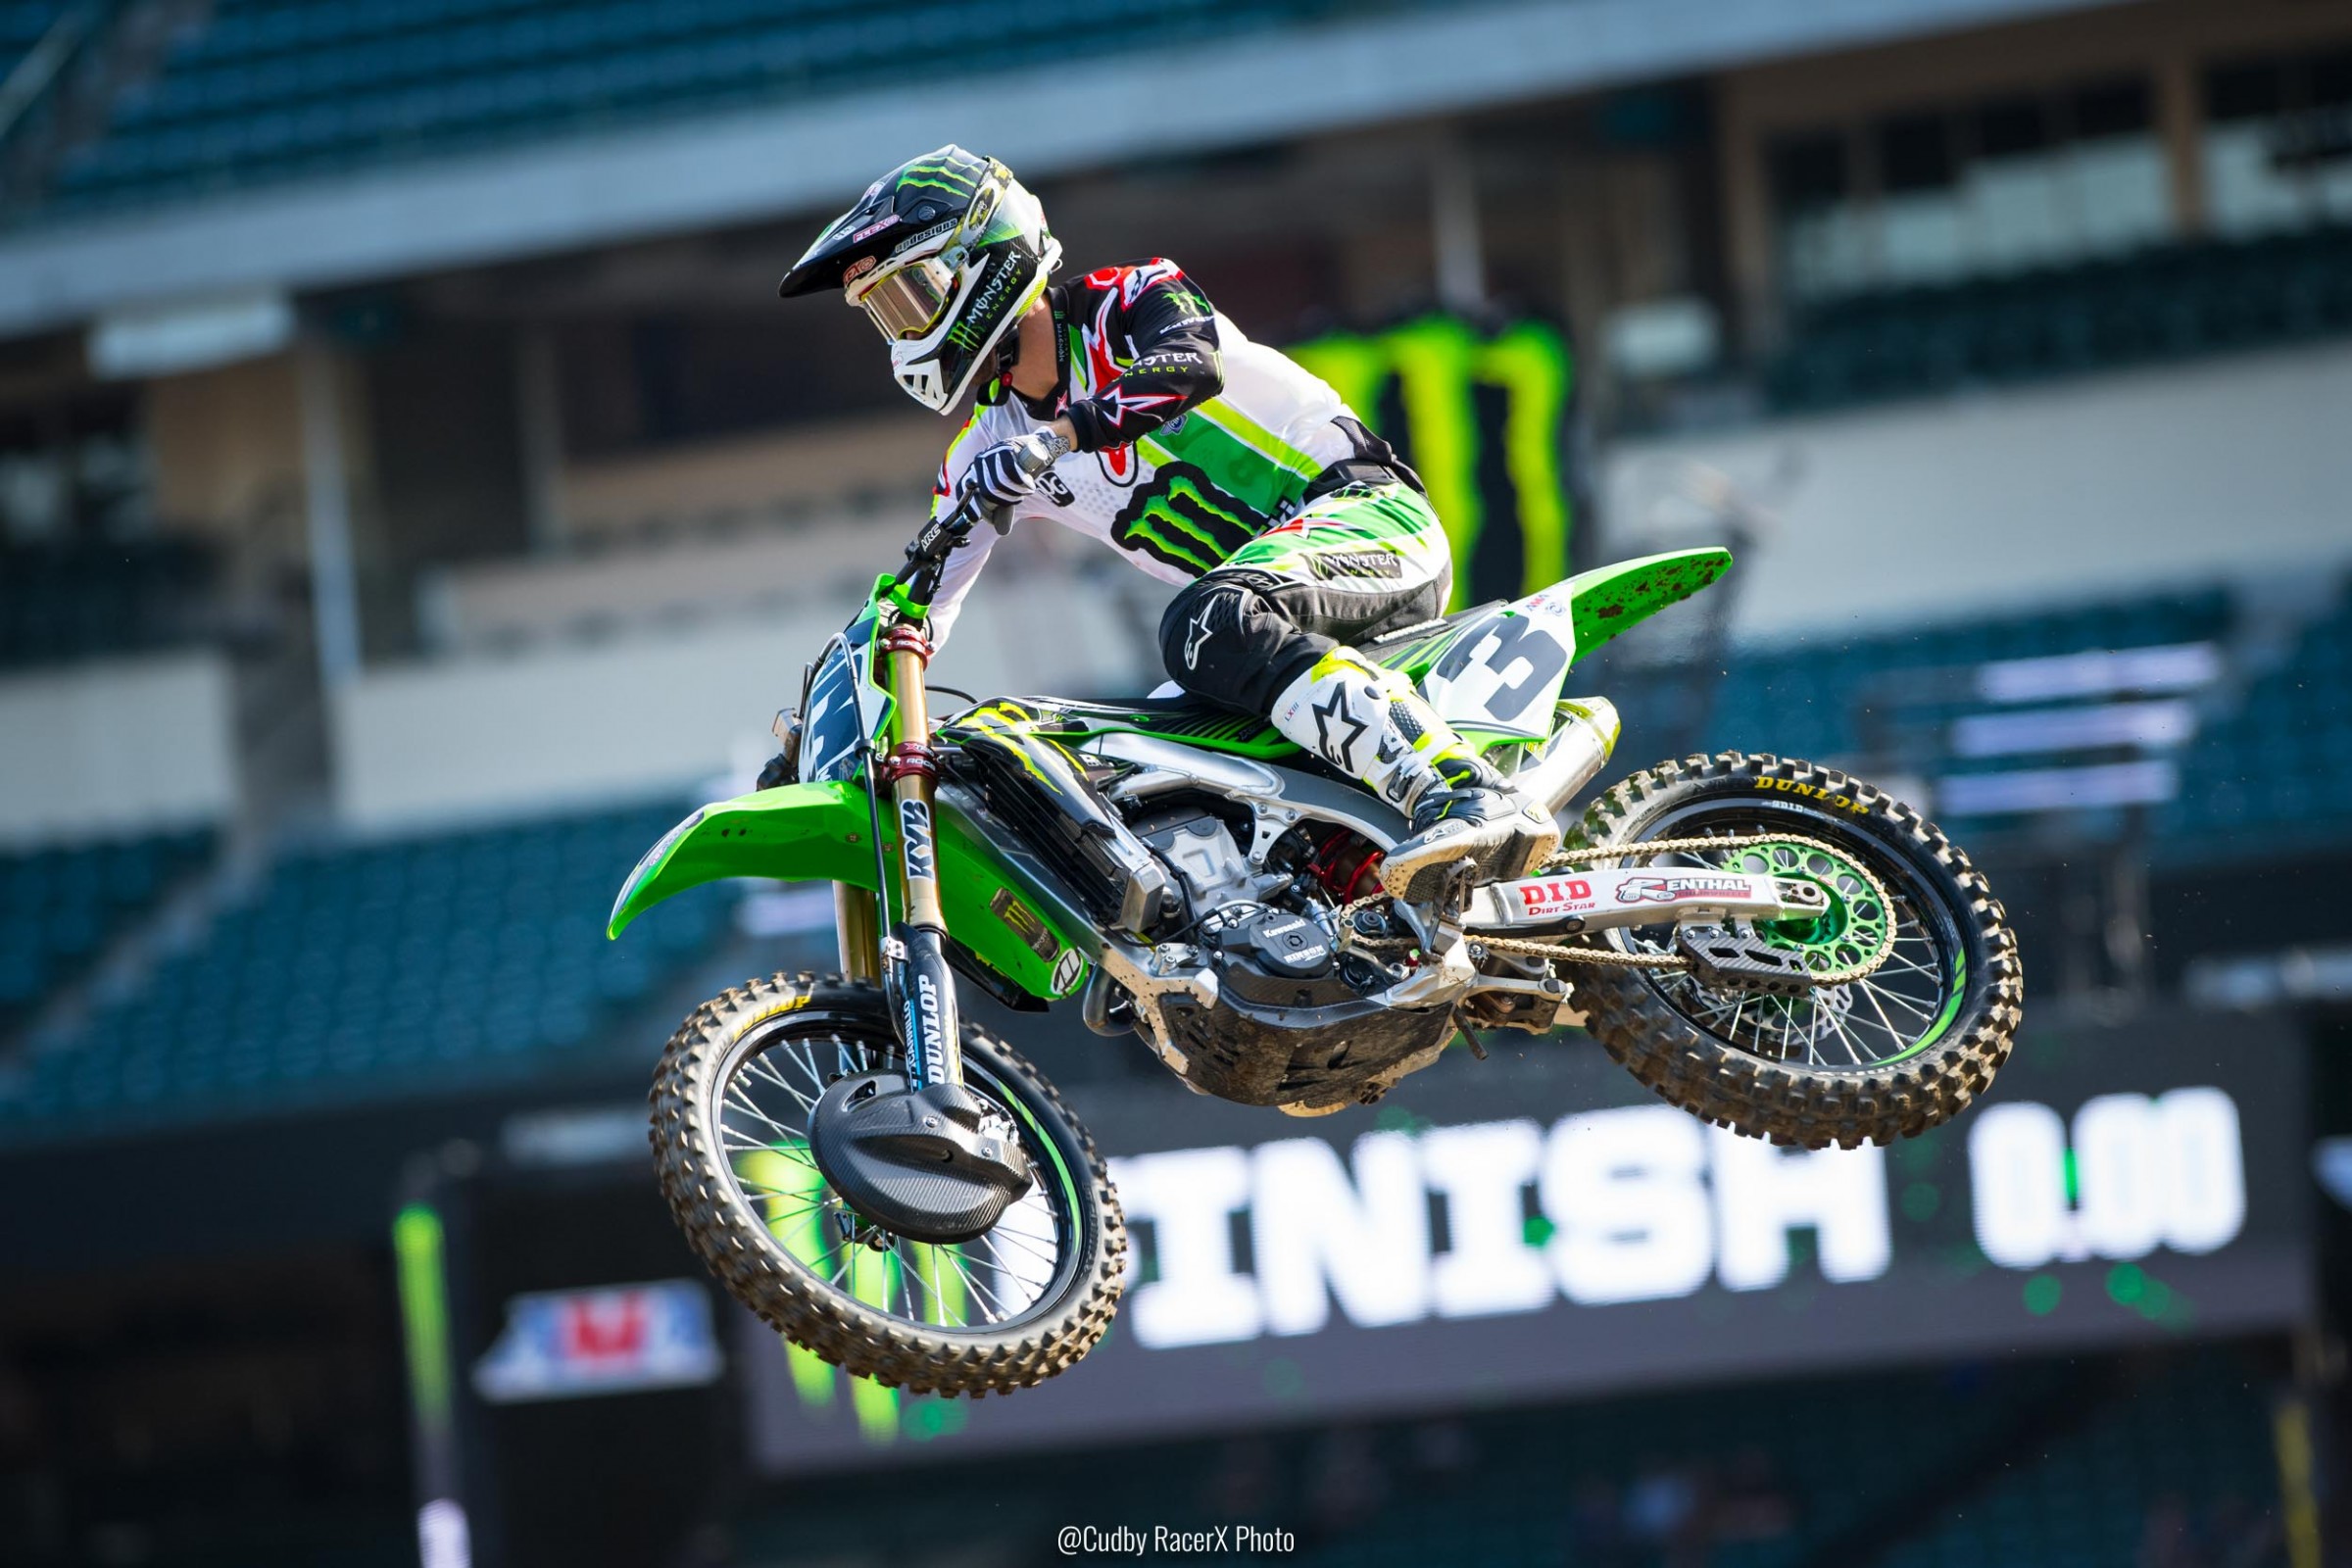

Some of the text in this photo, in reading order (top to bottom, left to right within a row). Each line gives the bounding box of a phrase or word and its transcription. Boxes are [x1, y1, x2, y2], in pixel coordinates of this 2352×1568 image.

[966, 250, 1022, 324] MONSTER
[986, 270, 1023, 320] ENERGY
[1124, 366, 1189, 378] NERGY
[1135, 352, 1203, 367] STER
[920, 522, 942, 553] ARC
[1436, 612, 1567, 722] 3
[1754, 776, 1870, 814] DUNLOP
[901, 798, 936, 880] KYB
[1262, 918, 1306, 938] Kawasaki
[918, 974, 946, 1084] DUNLOP
